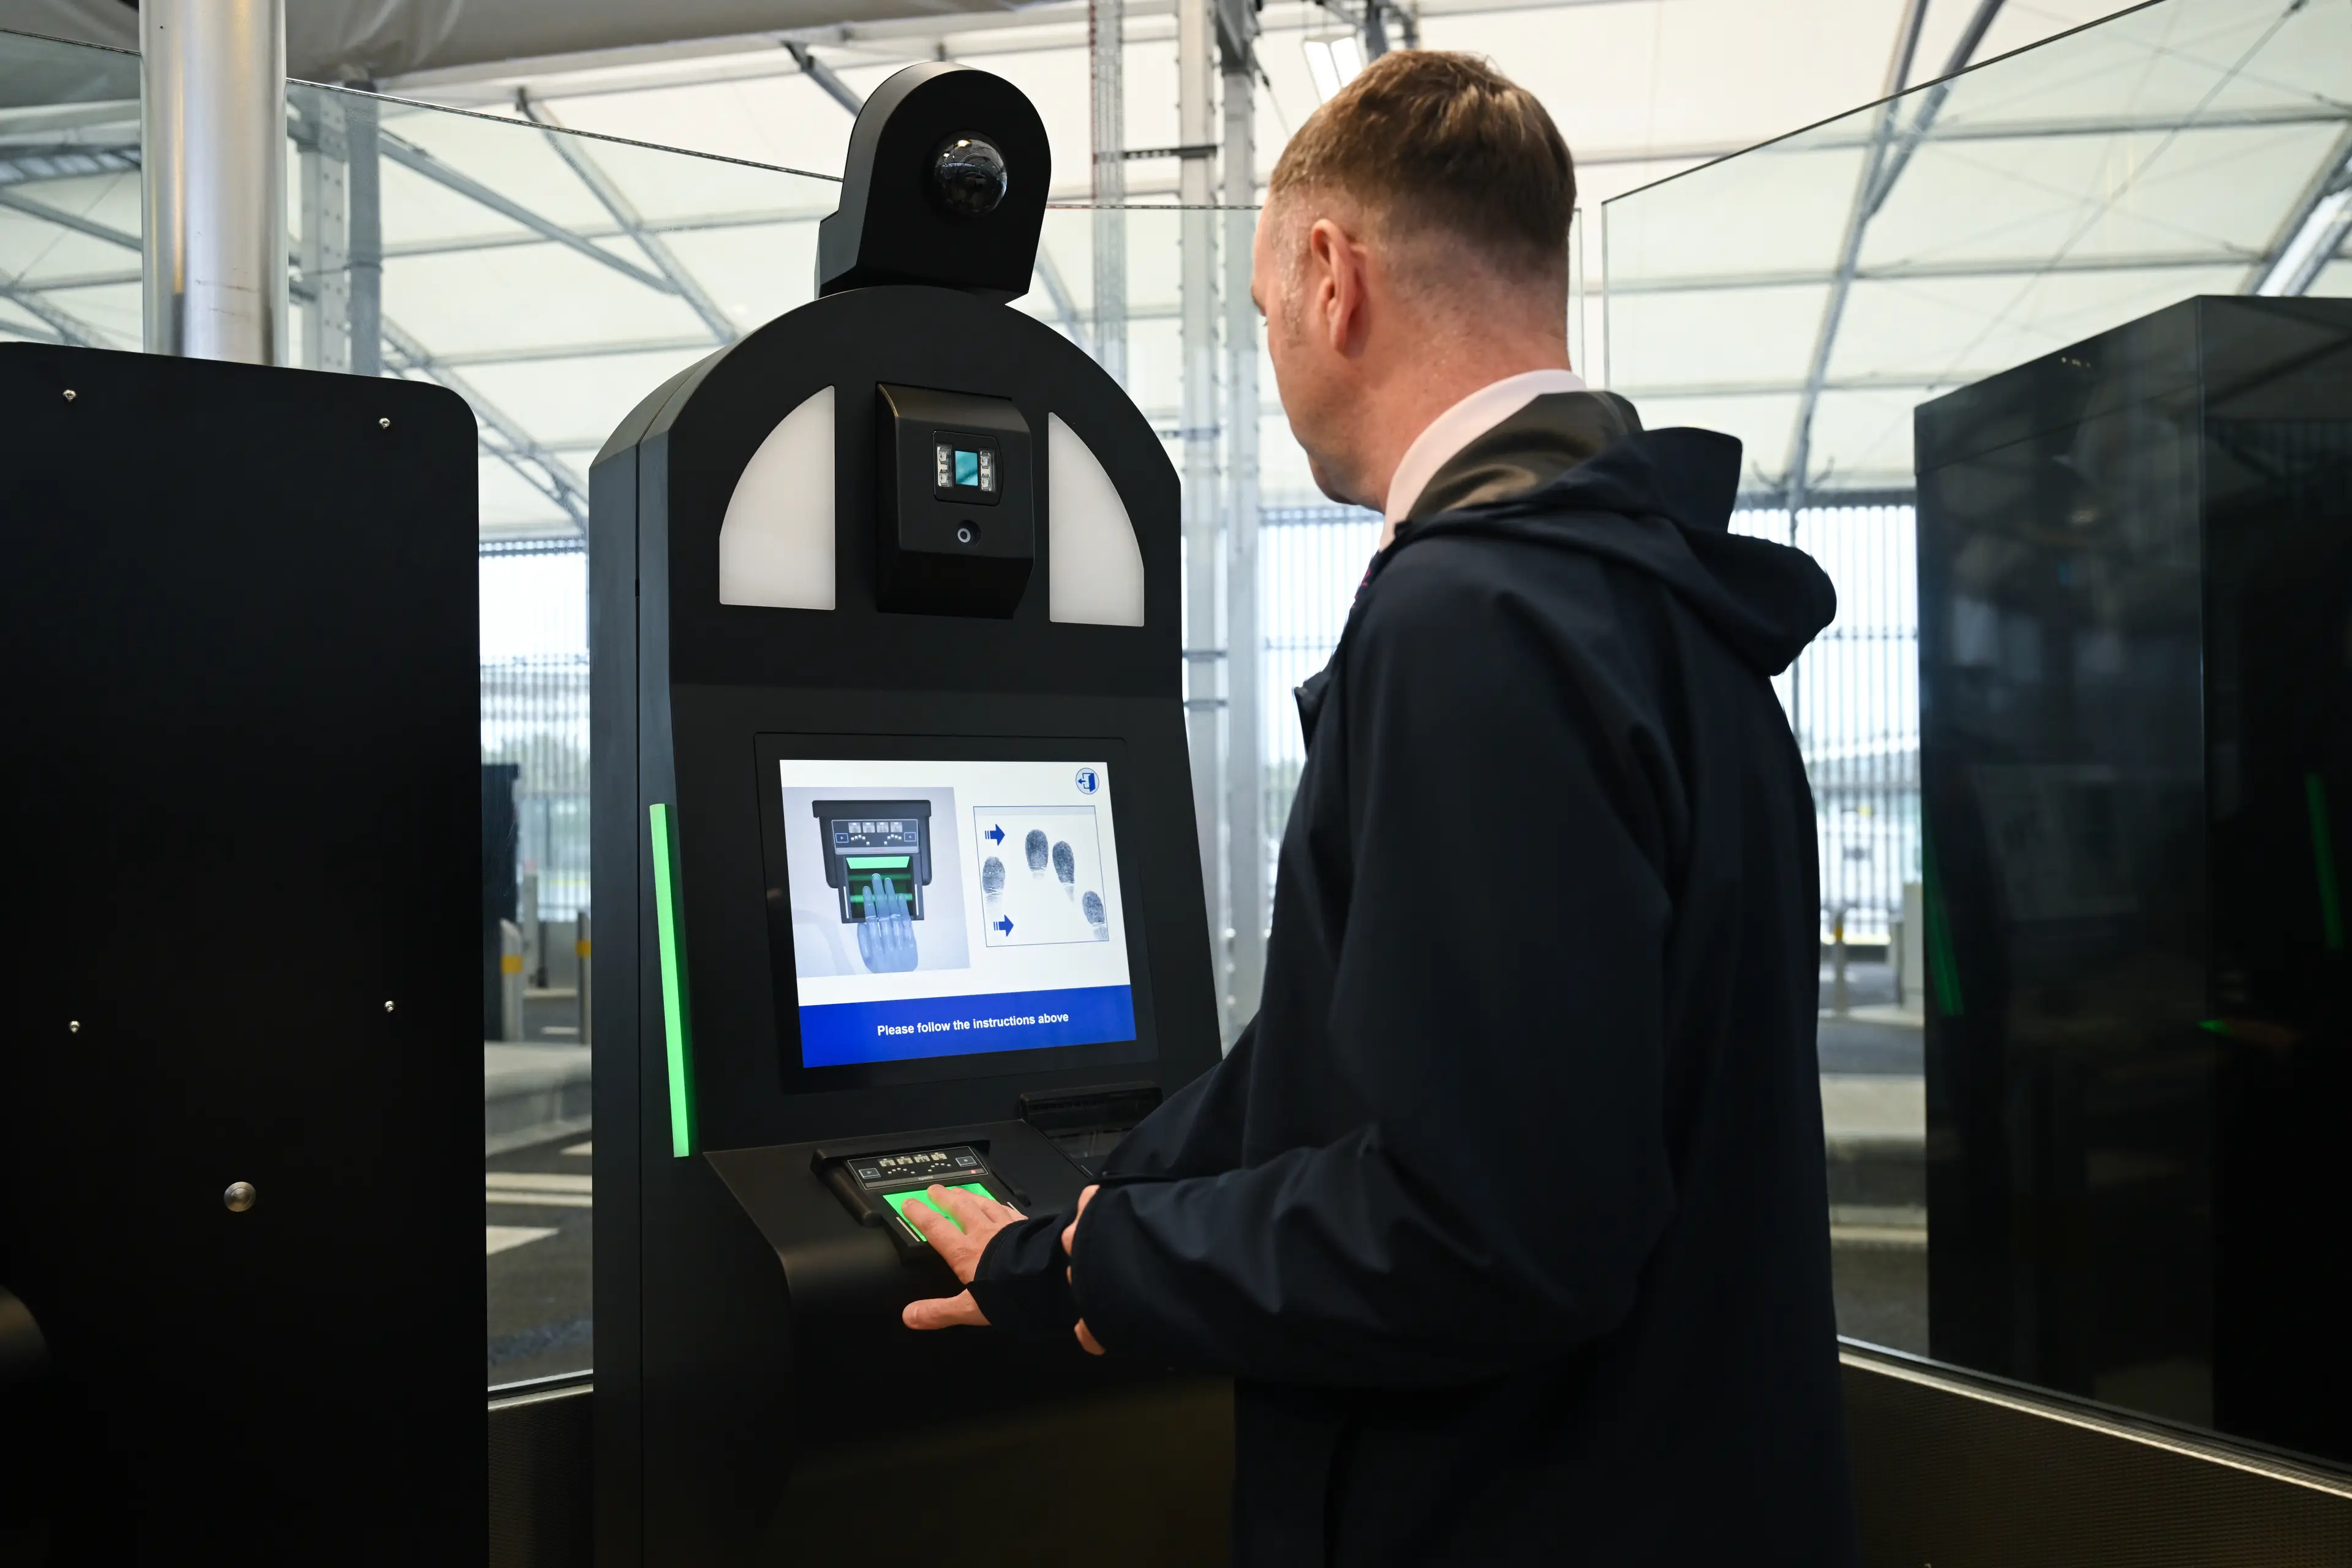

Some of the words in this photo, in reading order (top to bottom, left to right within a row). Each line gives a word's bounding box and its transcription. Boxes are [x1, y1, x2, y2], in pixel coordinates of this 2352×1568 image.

[877, 1025, 914, 1036] Please
[917, 1022, 951, 1033] follow
[953, 1019, 970, 1030] the
[973, 1016, 1036, 1029] instructions
[1038, 1013, 1069, 1024] above
